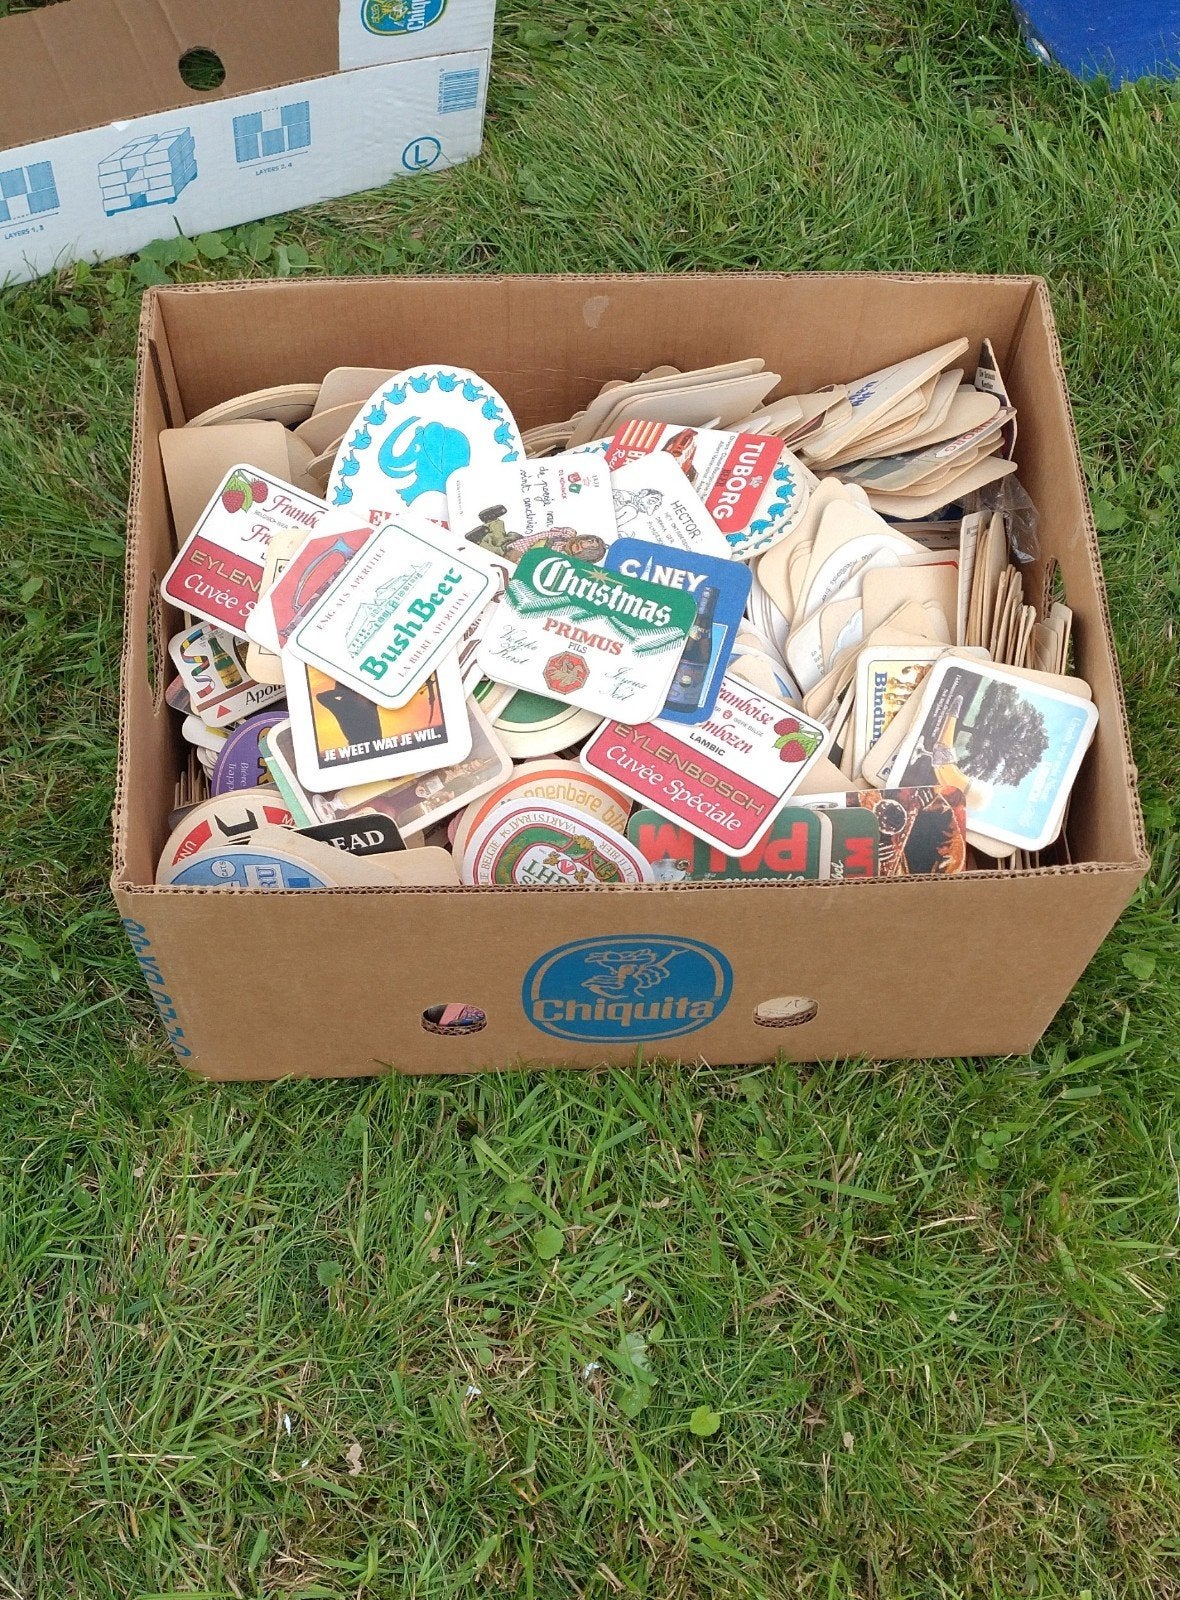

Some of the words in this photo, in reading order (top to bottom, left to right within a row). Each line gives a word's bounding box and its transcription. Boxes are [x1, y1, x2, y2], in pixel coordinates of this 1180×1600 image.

[407, 0, 431, 31] Chiq
[256, 166, 279, 176] LAYERS
[415, 146, 426, 164] L
[4, 228, 30, 240] LAYERS
[712, 440, 765, 521] TUBORG
[670, 499, 701, 541] HECTOR
[189, 549, 262, 593] EYLEN
[183, 572, 240, 610] Cuvée
[532, 557, 672, 626] Christmas
[542, 617, 624, 656] PRIMUS
[567, 641, 587, 654] PILS
[717, 683, 774, 727] ramboise
[324, 748, 337, 762] JE
[338, 742, 371, 758] WEET
[372, 736, 400, 752] WAT
[400, 732, 413, 746] JE
[414, 727, 442, 743] WIL.
[690, 733, 726, 757] LAMBIC
[614, 724, 765, 816] EYLENBOSCH
[606, 745, 664, 786] Cuvée
[663, 779, 742, 831] Spéciale
[328, 829, 386, 851] EAD
[513, 813, 577, 835] VAARTSTRAAT
[533, 995, 715, 1028] Chiquita
